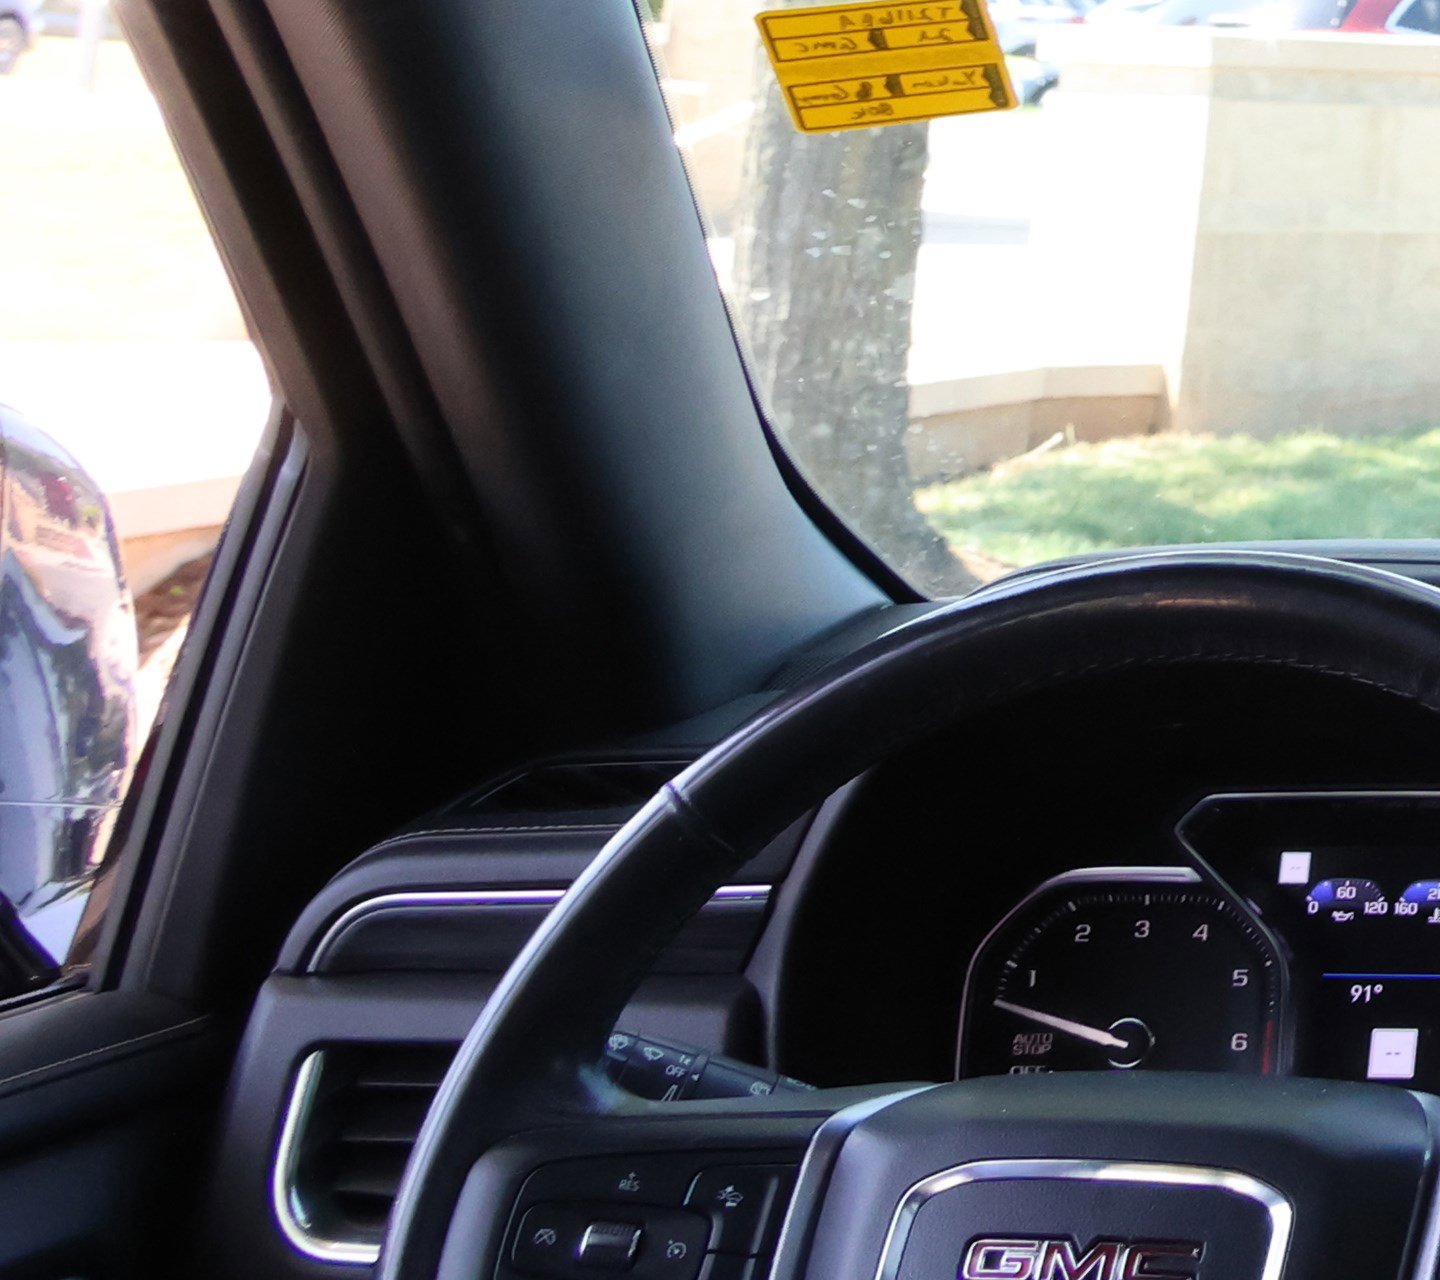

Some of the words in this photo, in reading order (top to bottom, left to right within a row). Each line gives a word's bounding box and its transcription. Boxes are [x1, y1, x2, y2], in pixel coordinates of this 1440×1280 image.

[1335, 886, 1357, 900] 60
[1307, 901, 1319, 915] 0
[1363, 901, 1388, 916] 120
[1393, 902, 1419, 916] 160
[1073, 924, 1091, 943] 2
[1134, 920, 1150, 938] 3
[1192, 924, 1210, 943] 4
[1026, 970, 1038, 988] 1
[1231, 968, 1249, 988] 5
[1349, 984, 1384, 1004] 91°
[1012, 1033, 1054, 1044] AUTO
[1230, 1033, 1248, 1051] 6
[1012, 1044, 1053, 1056] STOP
[665, 1064, 688, 1079] OFF
[617, 1178, 642, 1193] RES
[962, 1237, 1202, 1280] GMC
